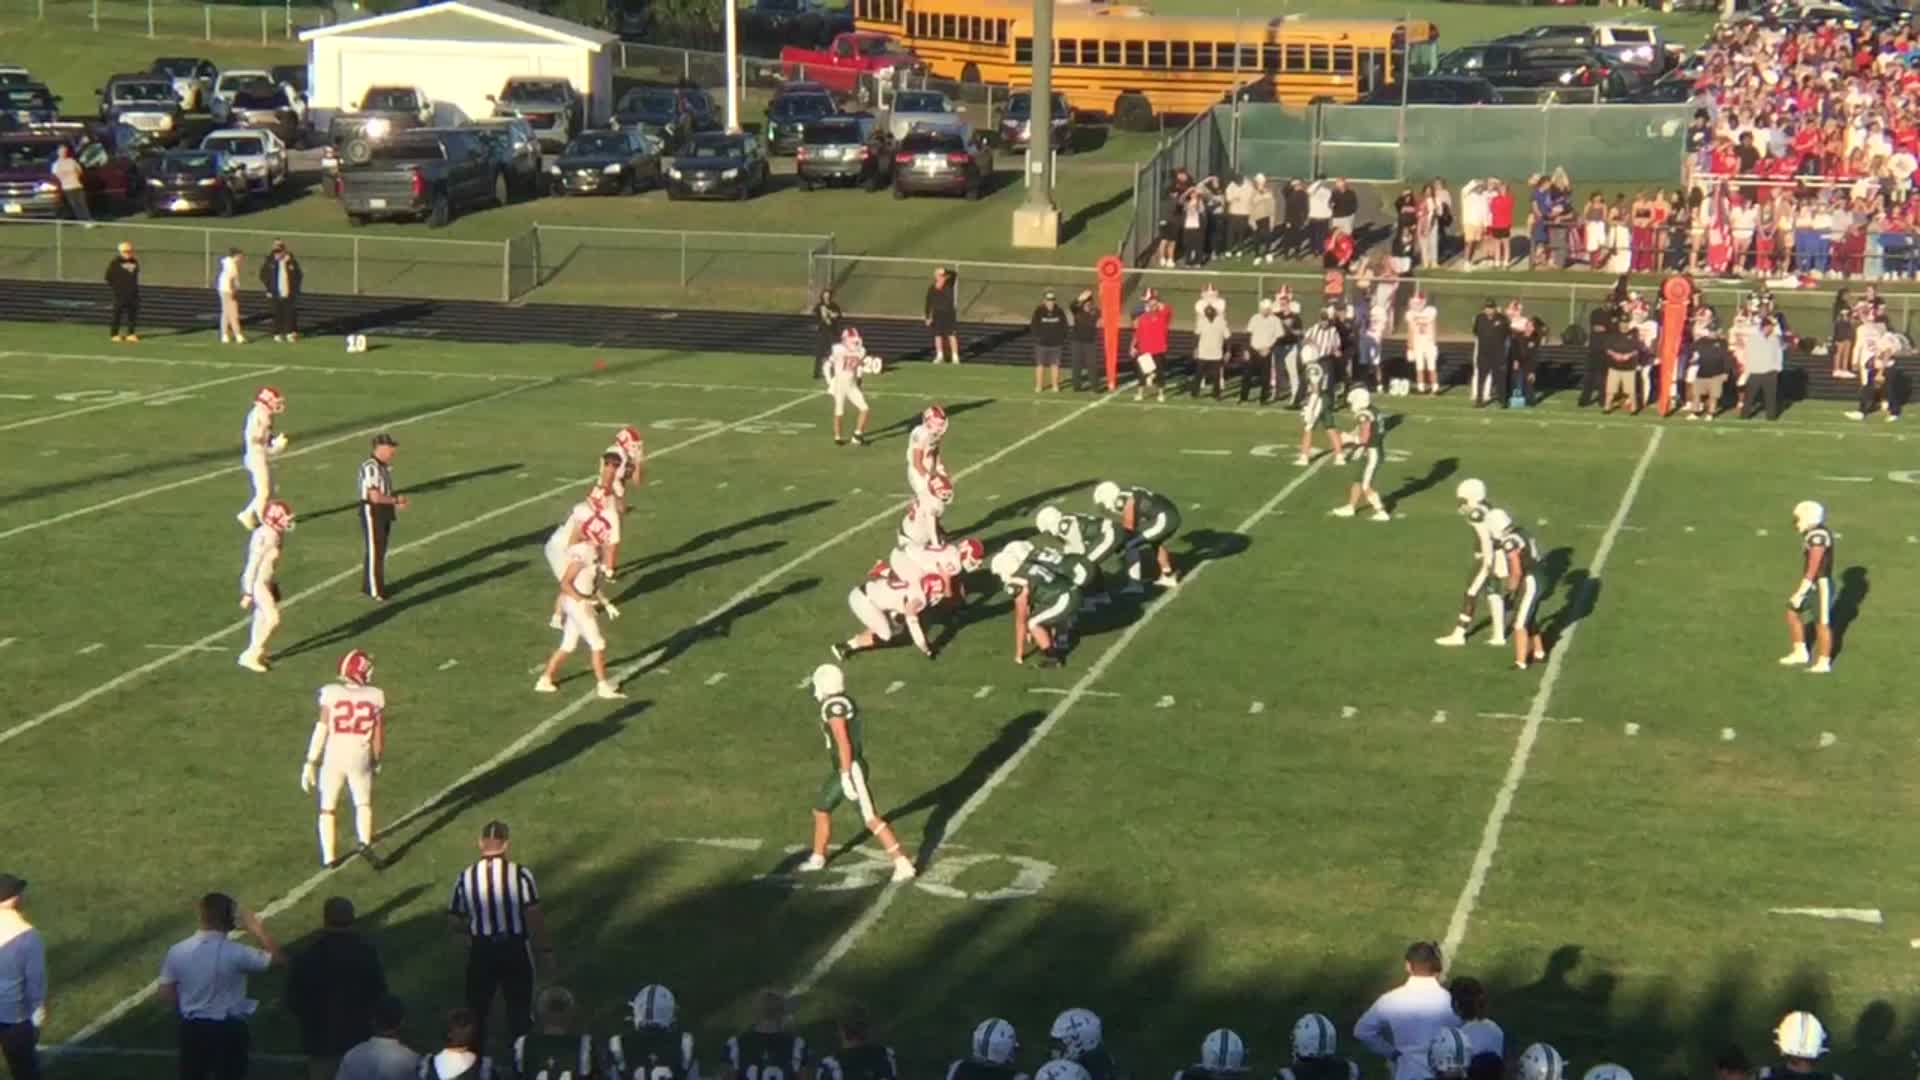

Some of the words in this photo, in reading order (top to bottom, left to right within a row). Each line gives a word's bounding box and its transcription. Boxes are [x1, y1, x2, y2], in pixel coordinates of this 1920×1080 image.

[1326, 272, 1344, 294] 2
[346, 336, 366, 352] 10
[864, 356, 882, 373] 20
[1389, 379, 1410, 395] 30
[334, 701, 376, 733] 22
[753, 844, 1056, 900] 30
